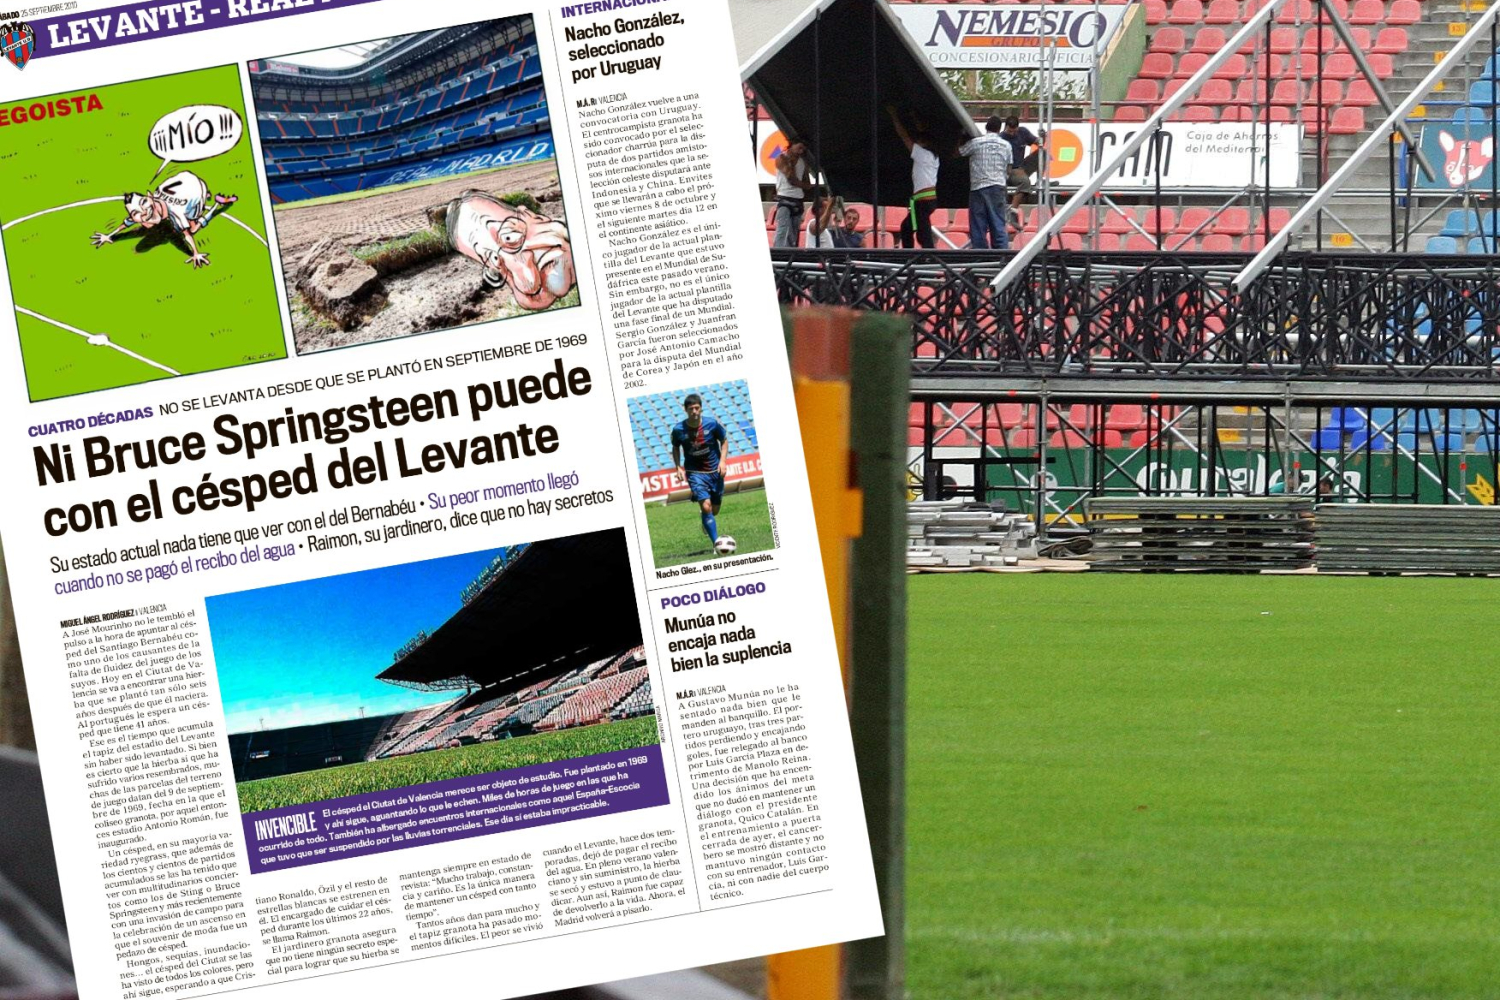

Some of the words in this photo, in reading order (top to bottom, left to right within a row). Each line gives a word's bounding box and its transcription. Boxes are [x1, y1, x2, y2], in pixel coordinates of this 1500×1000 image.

[924, 9, 1108, 48] NEMESIO
[1187, 131, 1213, 143] Caja
[1216, 131, 1230, 142] de
[1185, 144, 1203, 154] del
